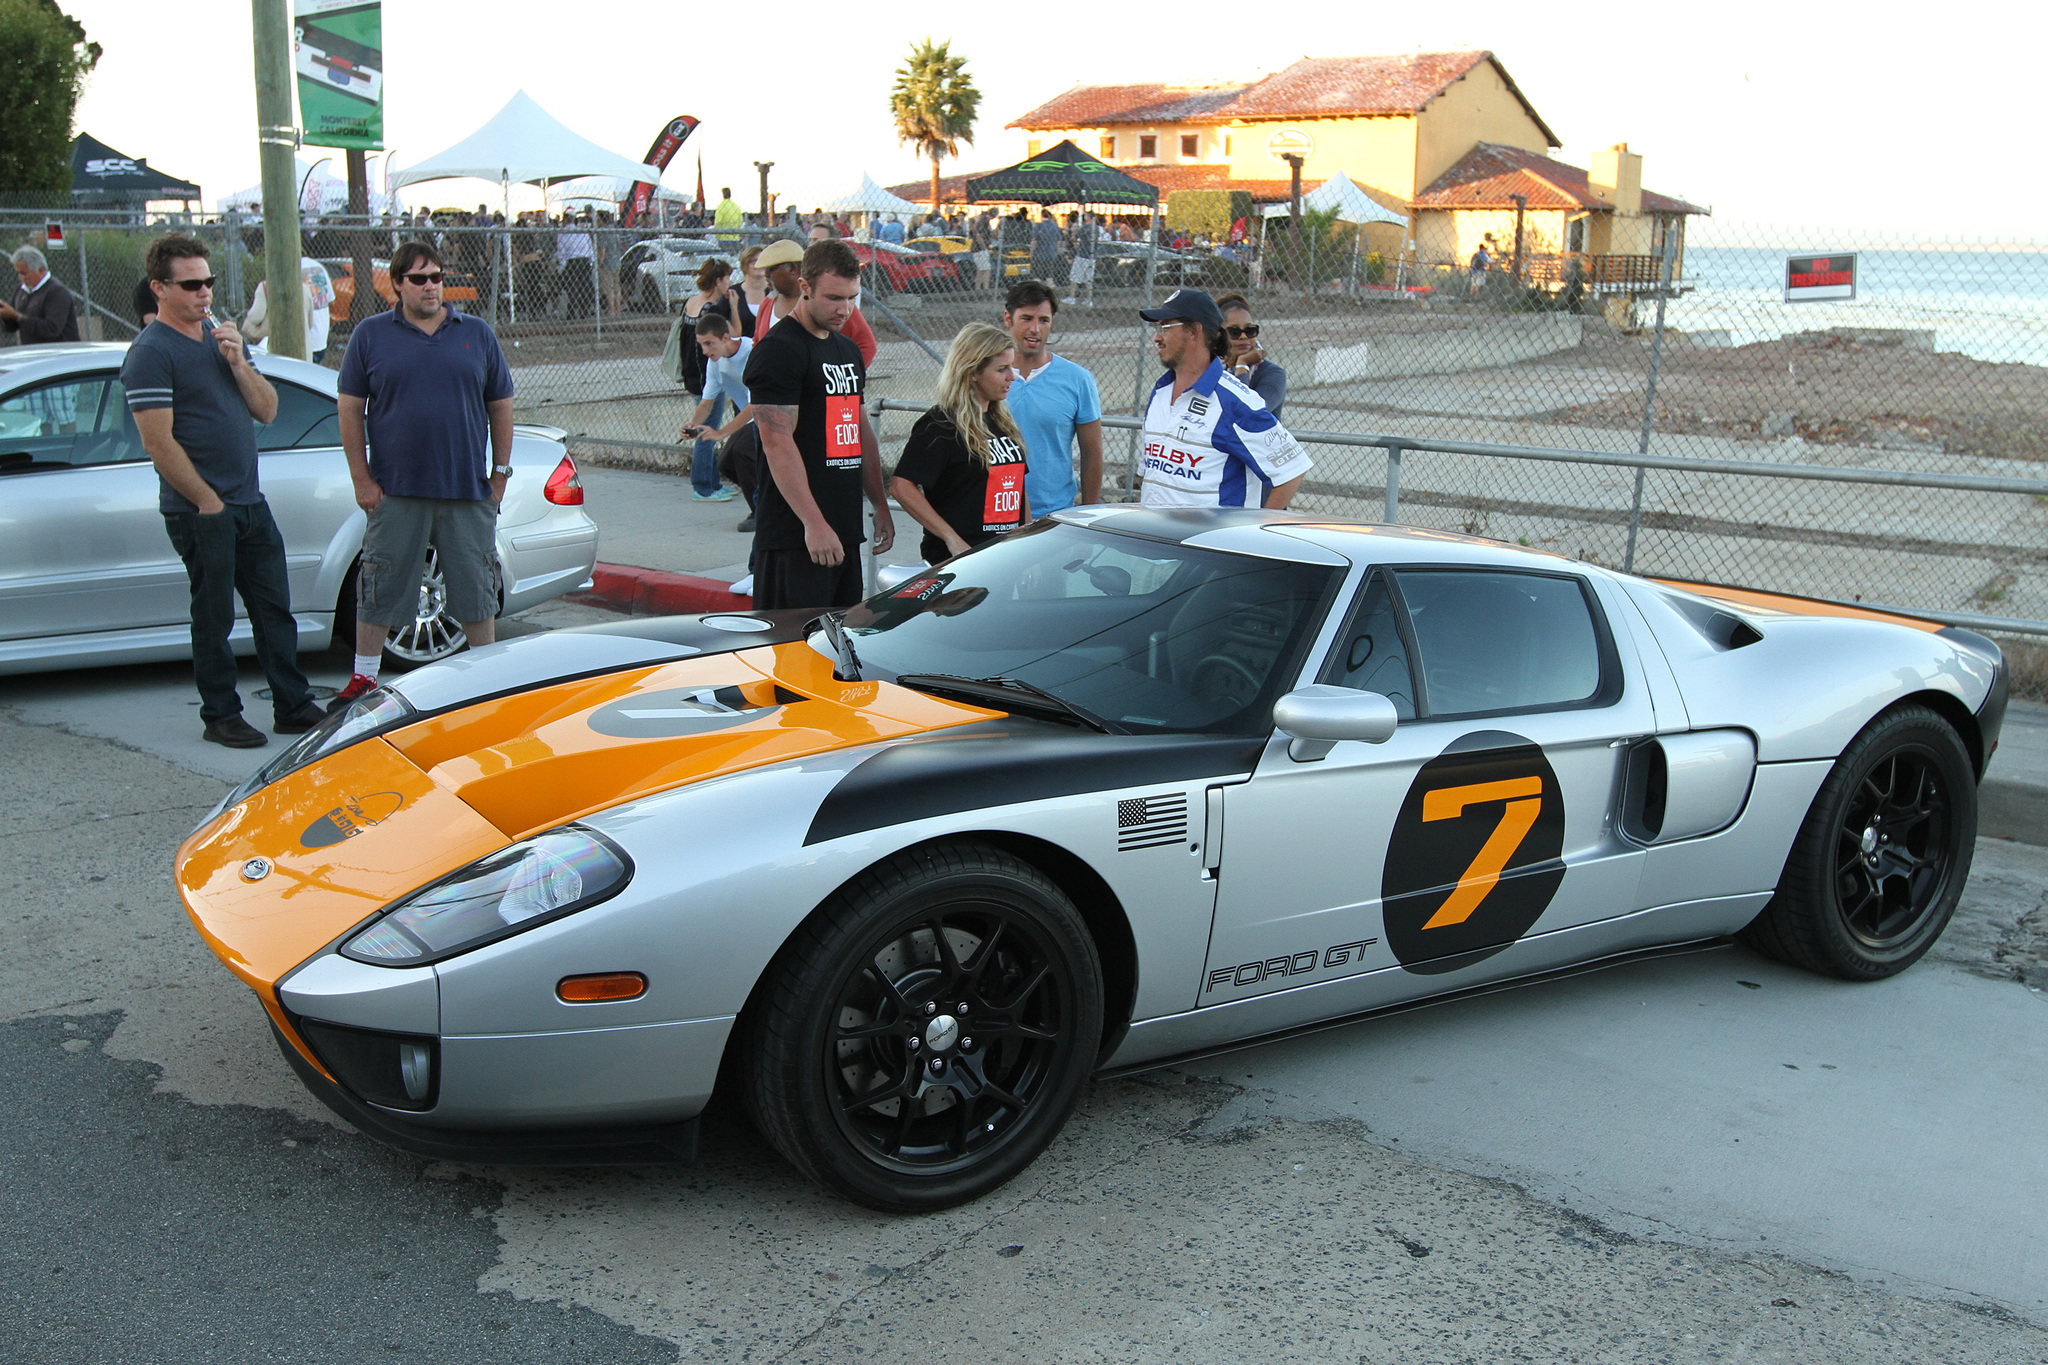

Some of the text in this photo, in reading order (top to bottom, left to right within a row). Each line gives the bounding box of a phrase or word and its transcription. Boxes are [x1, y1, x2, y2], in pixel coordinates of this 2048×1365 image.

[320, 126, 369, 137] CALIFORNIA
[1813, 258, 1830, 272] NO
[1790, 270, 1852, 287] TRESPASSING
[822, 362, 859, 395] STAFF
[835, 423, 859, 446] EOCR
[987, 436, 1023, 465] STAFF
[1144, 443, 1205, 468] HELBY
[1144, 458, 1202, 481] ERICAN
[994, 491, 1020, 512] EOCR
[1421, 776, 1542, 930] 7
[1206, 937, 1378, 993] FORD GT
[929, 1030, 948, 1044] FORD
